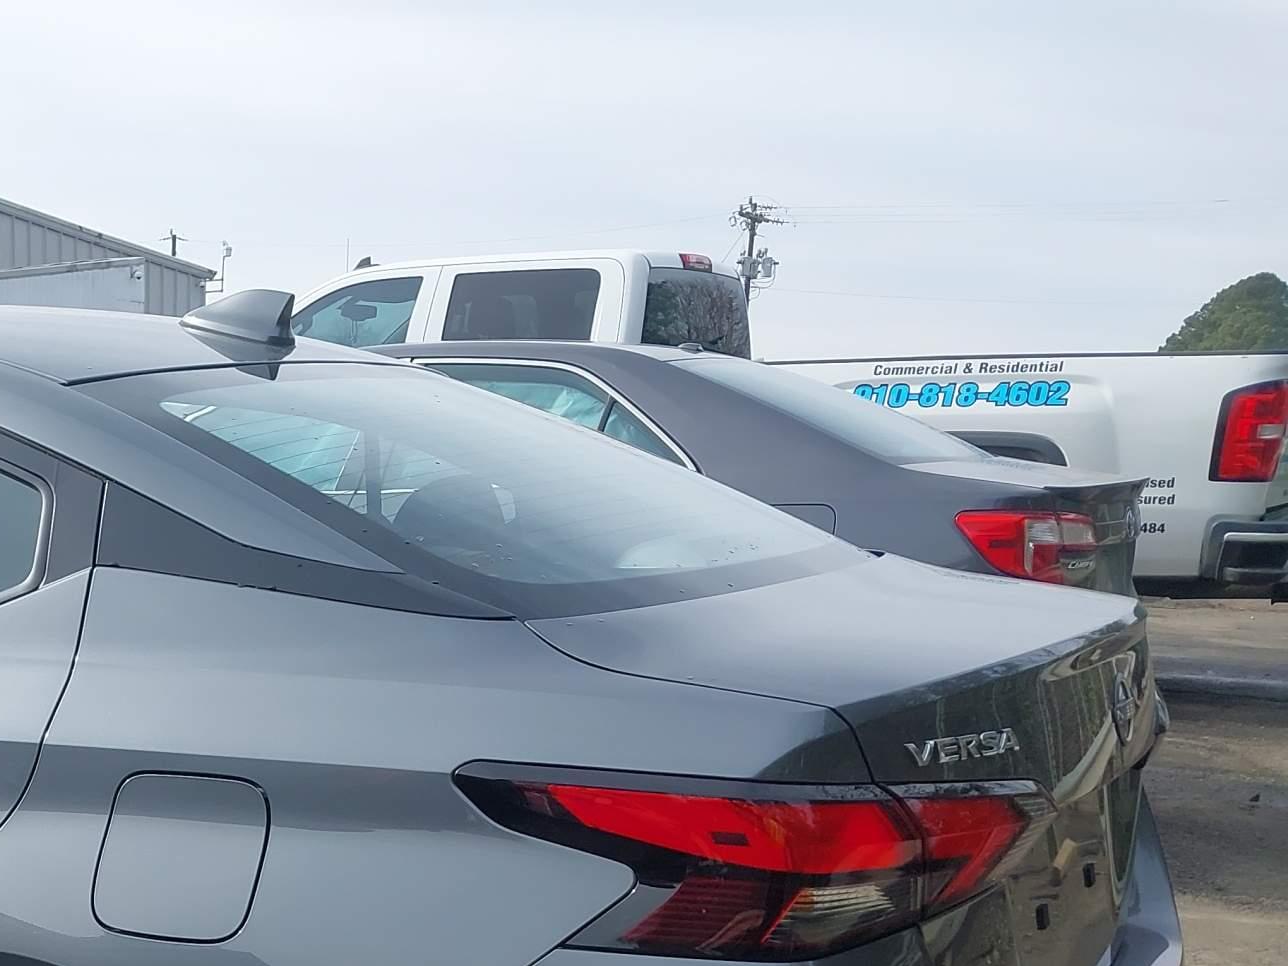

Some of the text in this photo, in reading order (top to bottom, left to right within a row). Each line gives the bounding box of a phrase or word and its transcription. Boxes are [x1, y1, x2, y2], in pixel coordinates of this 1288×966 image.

[873, 361, 1065, 376] Commercial & Residential
[904, 728, 1020, 767] VERSA
